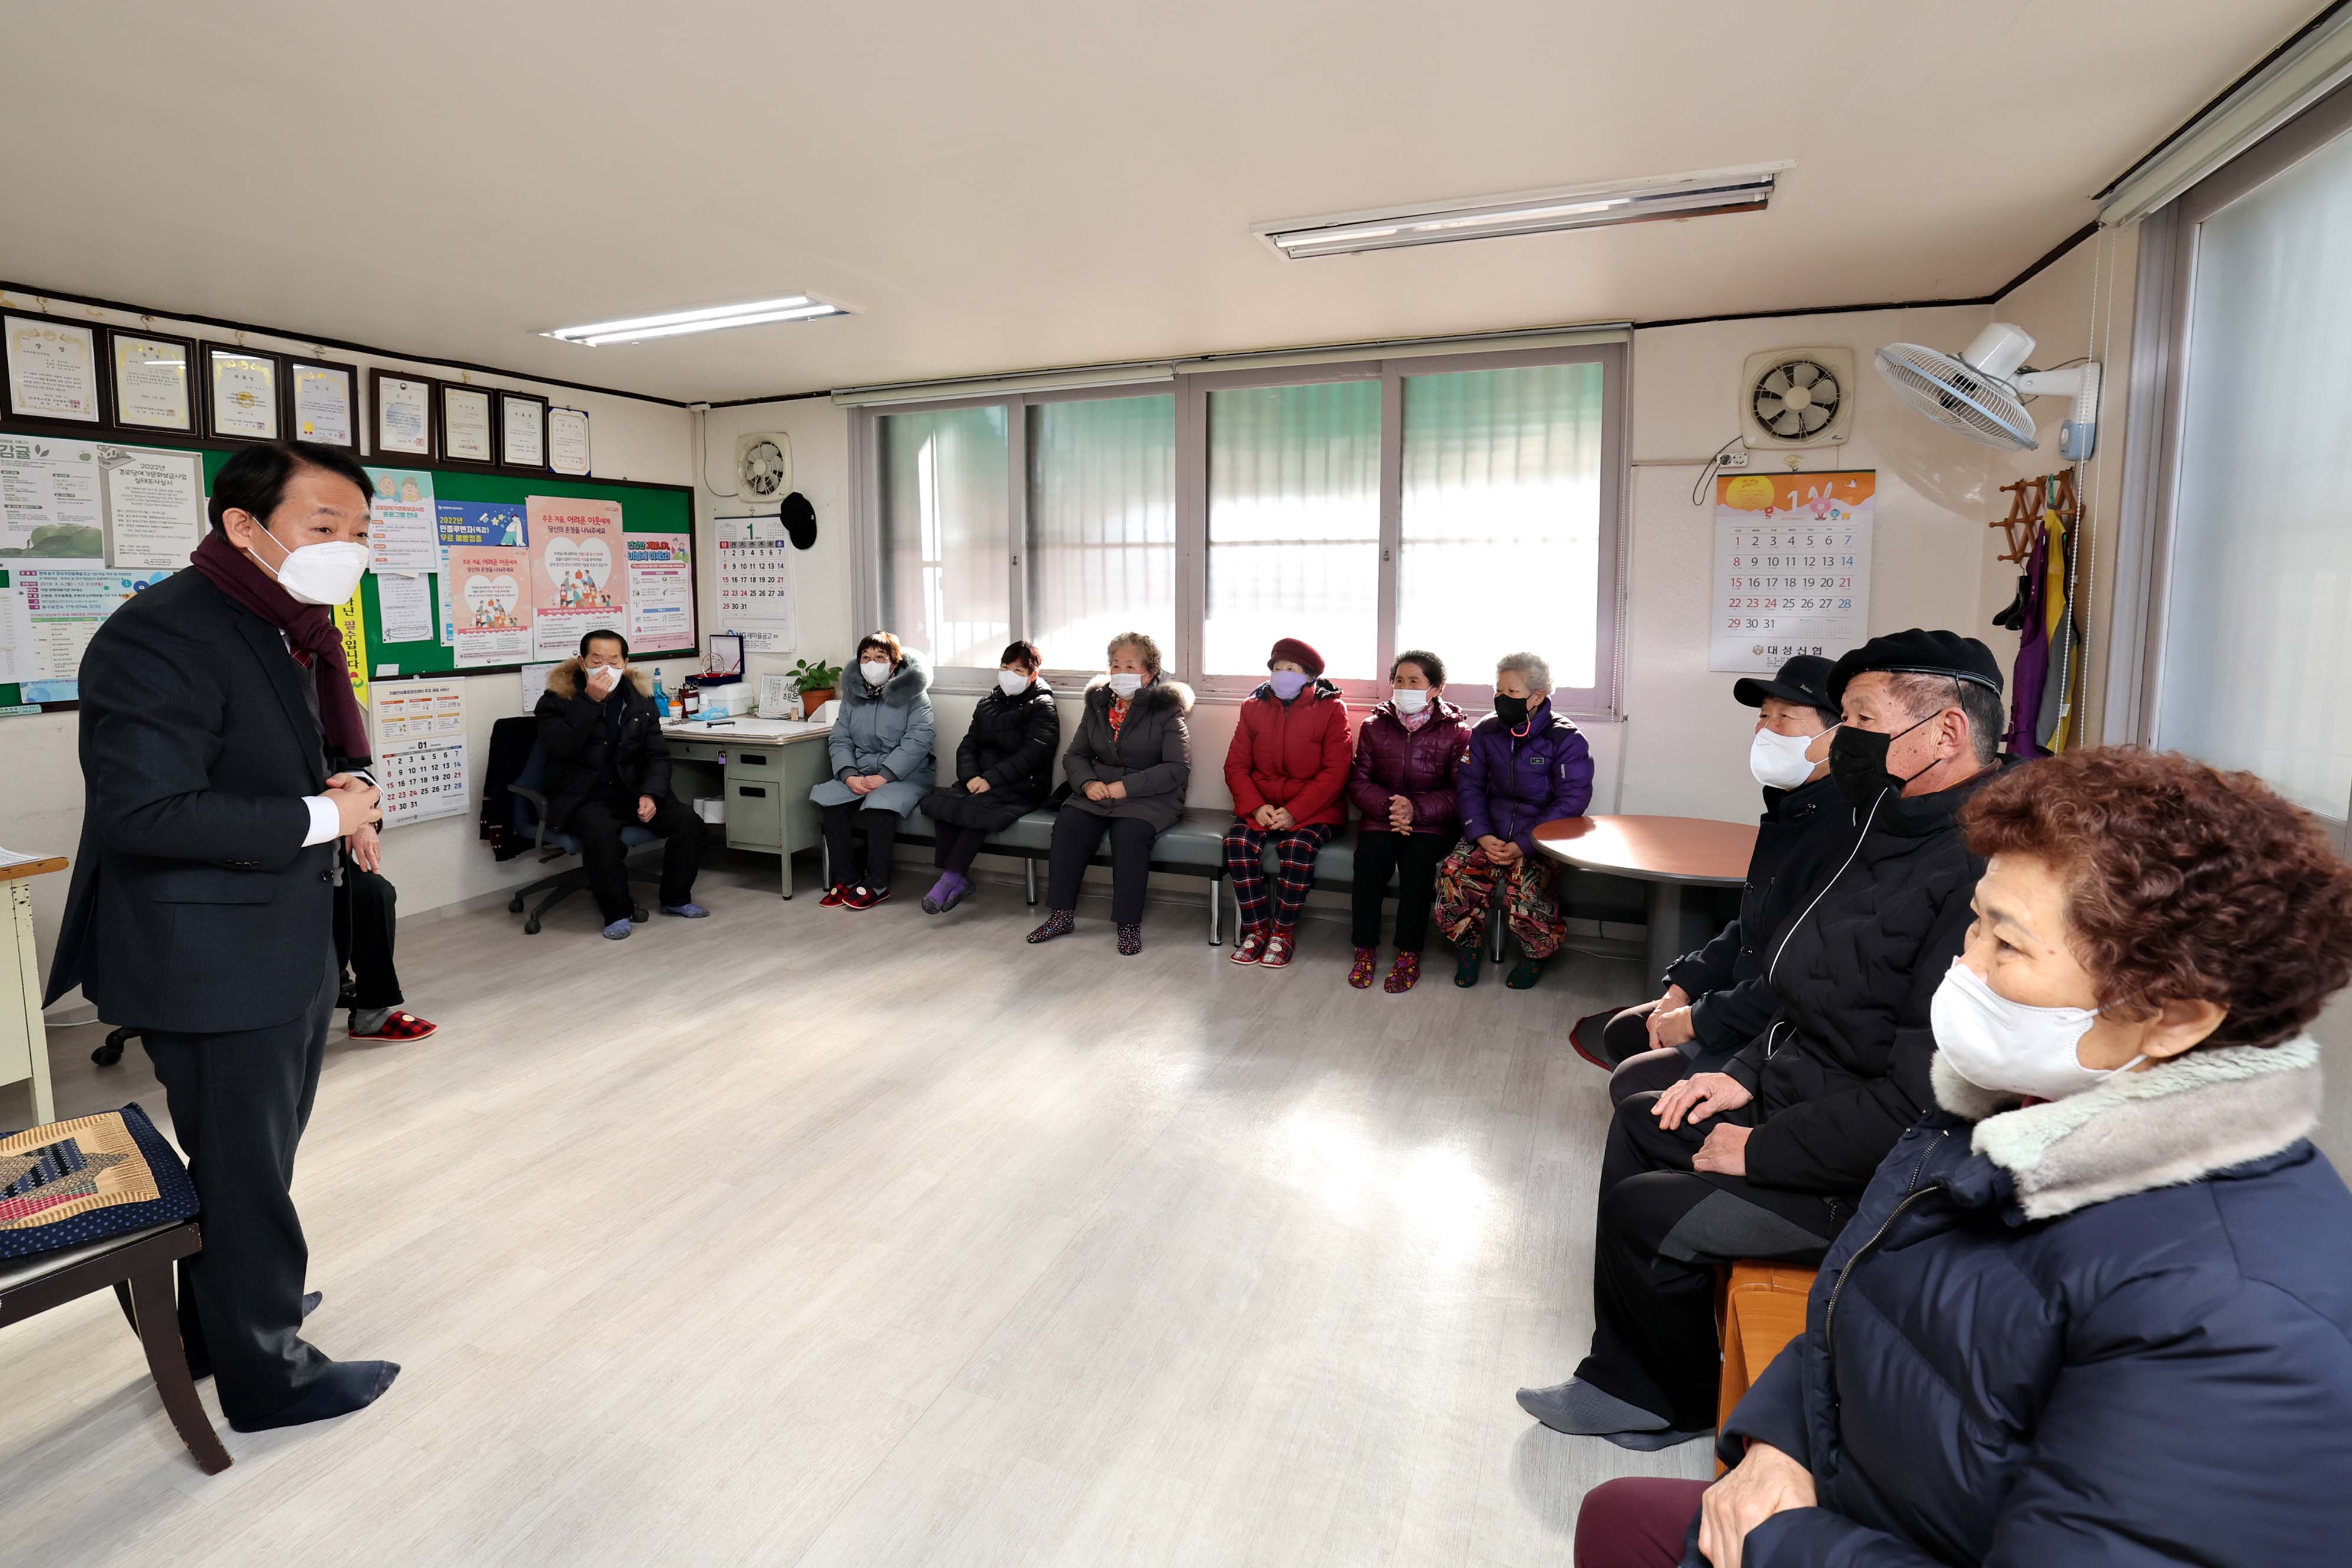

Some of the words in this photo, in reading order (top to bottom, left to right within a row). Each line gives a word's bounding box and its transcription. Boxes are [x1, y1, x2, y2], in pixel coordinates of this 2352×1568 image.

[567, 516, 586, 524] 어려운
[747, 524, 753, 540] 1
[1736, 537, 1739, 545] 1
[1753, 537, 1759, 545] 2
[1770, 536, 1776, 545] 3
[1788, 537, 1795, 545] 4
[1807, 536, 1813, 545] 5
[1825, 536, 1832, 545] 6
[1845, 535, 1851, 544] 7
[1734, 557, 1740, 566] 8
[1752, 557, 1758, 566] 9
[1768, 557, 1779, 566] 10
[1786, 557, 1795, 566] 11
[1804, 557, 1815, 566] 12
[1823, 557, 1834, 566] 13
[1842, 557, 1853, 566] 14
[1731, 578, 1742, 587] 15
[1749, 578, 1760, 587] 16
[1766, 578, 1778, 587] 17
[1785, 578, 1796, 587] 18
[1803, 578, 1815, 587] 19
[1820, 578, 1833, 587] 20
[1839, 578, 1850, 587] 21
[1729, 598, 1741, 607] 22
[1747, 599, 1759, 607] 23
[1765, 599, 1776, 607] 24
[1783, 599, 1795, 607] 25
[1801, 599, 1814, 608] 26
[1819, 599, 1832, 608] 27
[1838, 599, 1851, 608] 28
[1728, 619, 1740, 628] 29
[1746, 619, 1758, 628] 30
[1764, 619, 1774, 628] 31
[344, 620, 360, 669] 필수입니다
